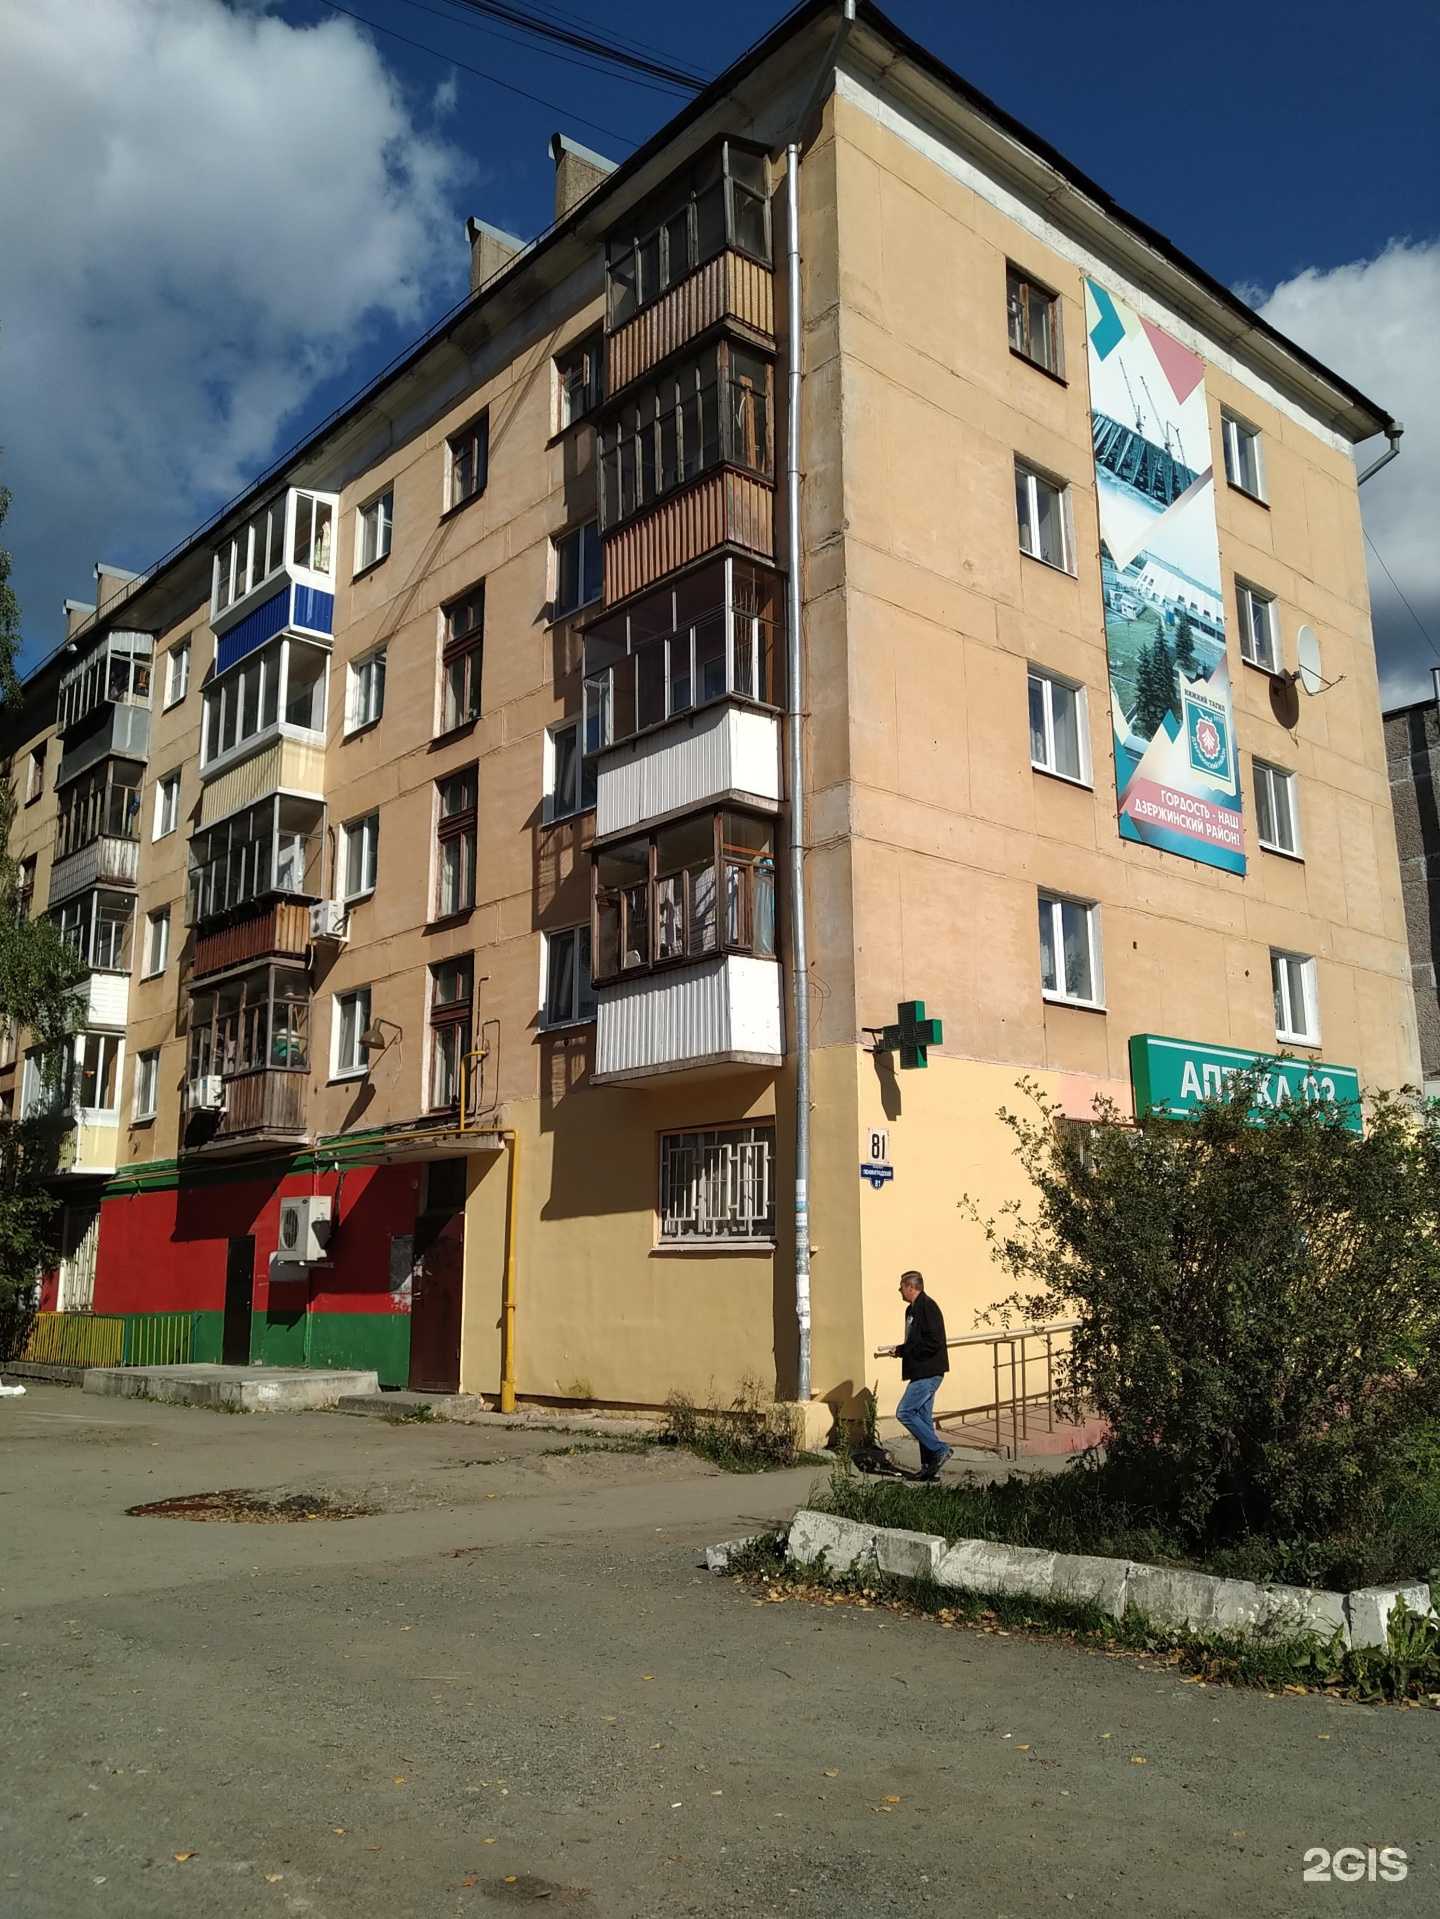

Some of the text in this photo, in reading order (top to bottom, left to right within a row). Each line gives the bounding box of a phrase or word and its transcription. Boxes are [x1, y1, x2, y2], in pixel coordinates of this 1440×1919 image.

[1134, 799, 1241, 847] ДЗЕРЖИНСКИЙ РАЙОН!
[1161, 790, 1210, 819] ГОРДОСТЬ
[1217, 810, 1240, 830] НАШ
[871, 1133, 885, 1160] 81
